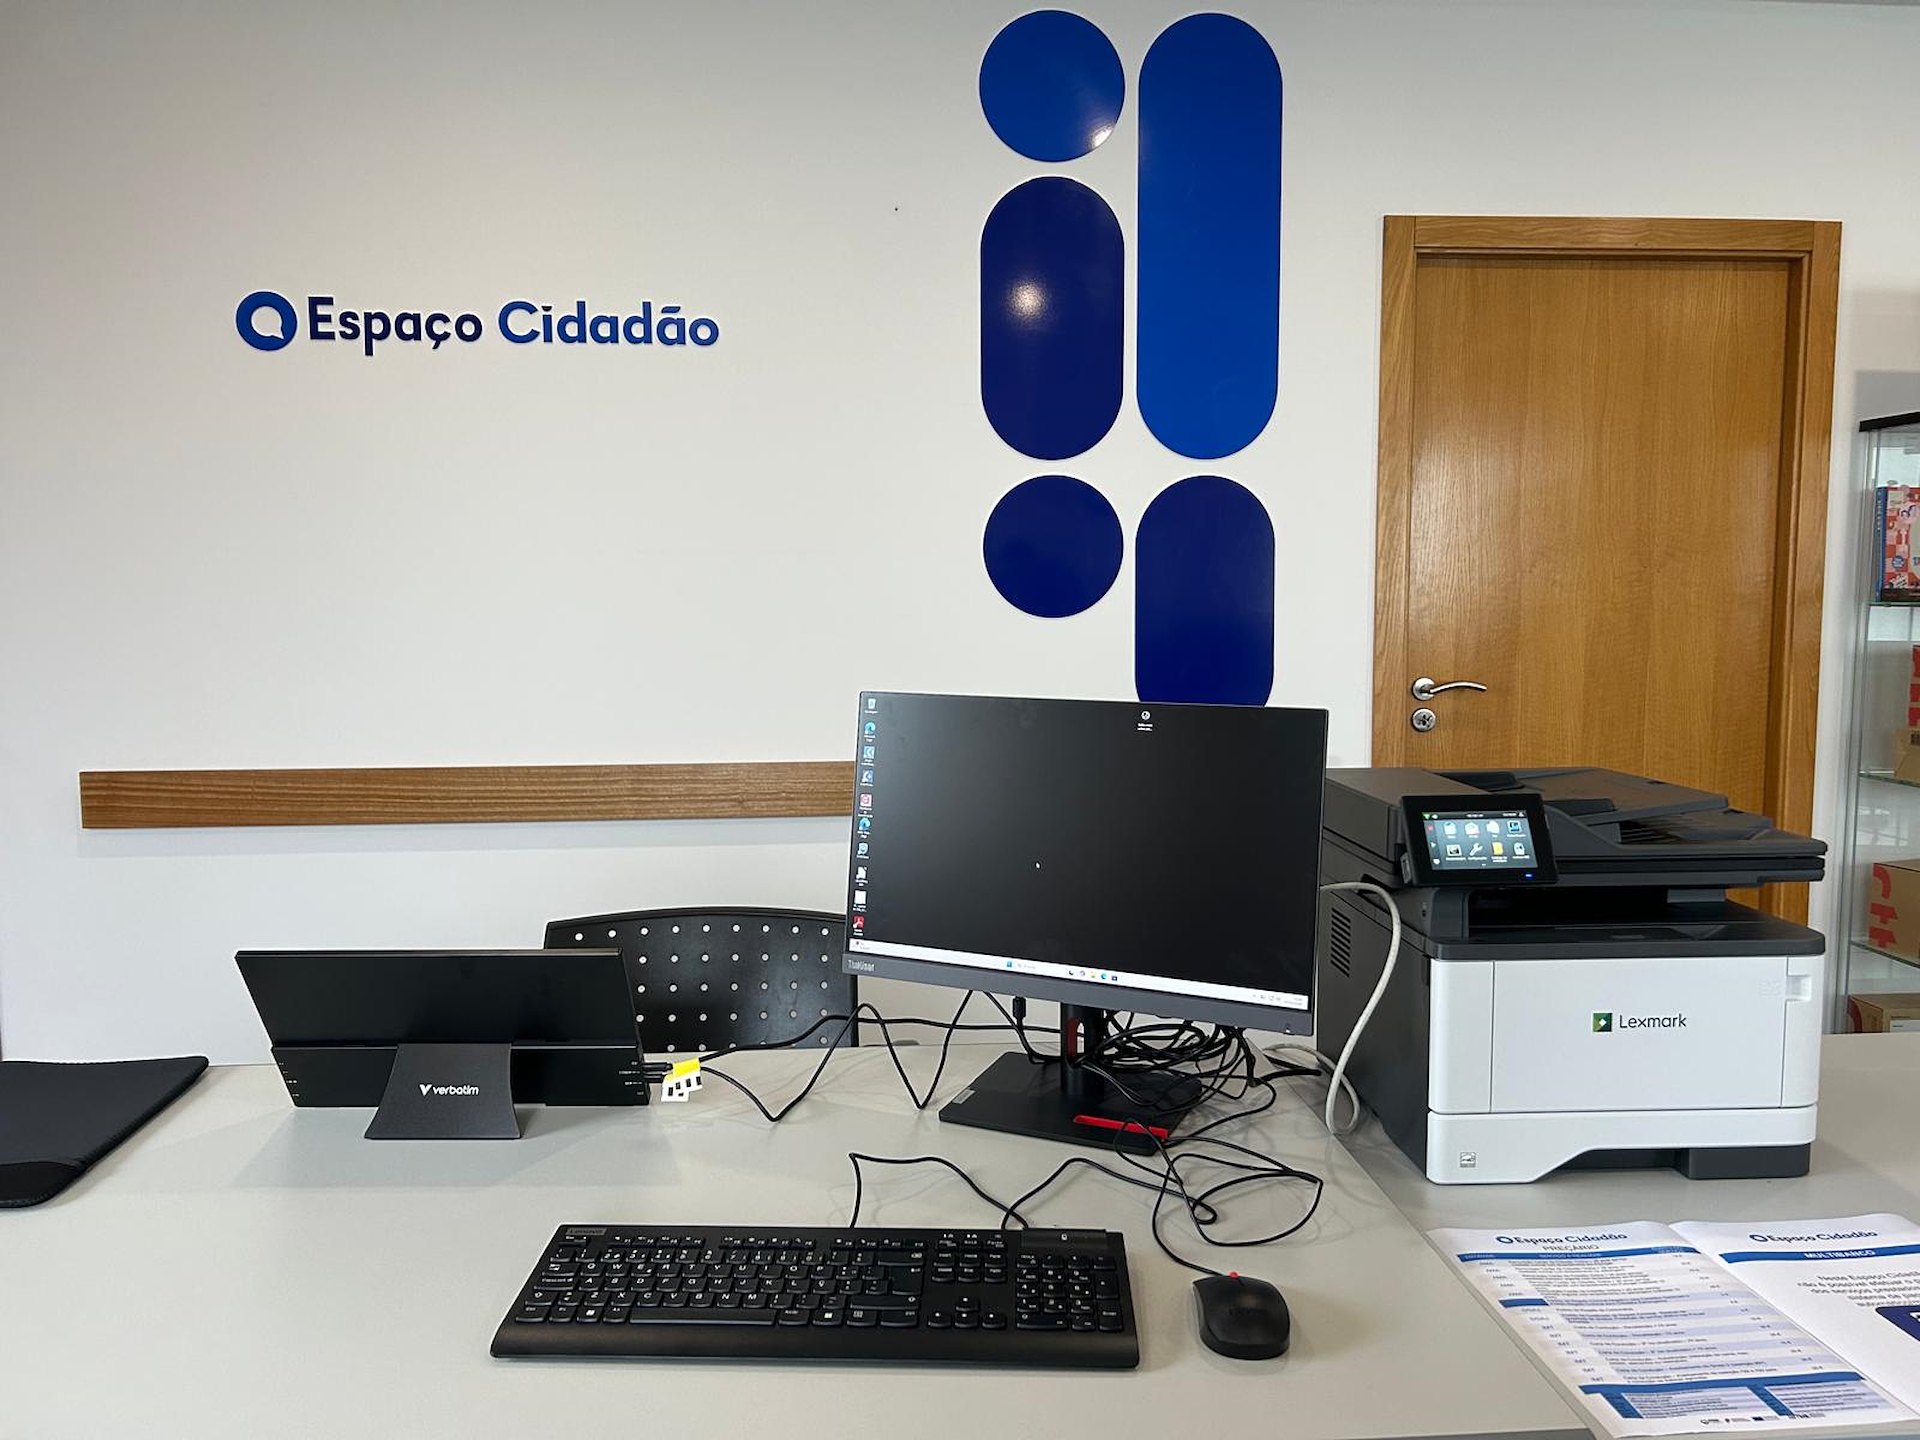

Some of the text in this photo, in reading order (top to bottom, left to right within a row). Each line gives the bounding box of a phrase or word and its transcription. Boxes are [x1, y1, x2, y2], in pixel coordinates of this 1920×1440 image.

[307, 296, 720, 357] Espaço Cidadão
[1619, 1013, 1687, 1029] Lexmark
[433, 1085, 479, 1096] verbatim
[1514, 1233, 1628, 1245] Espaço Cidadão
